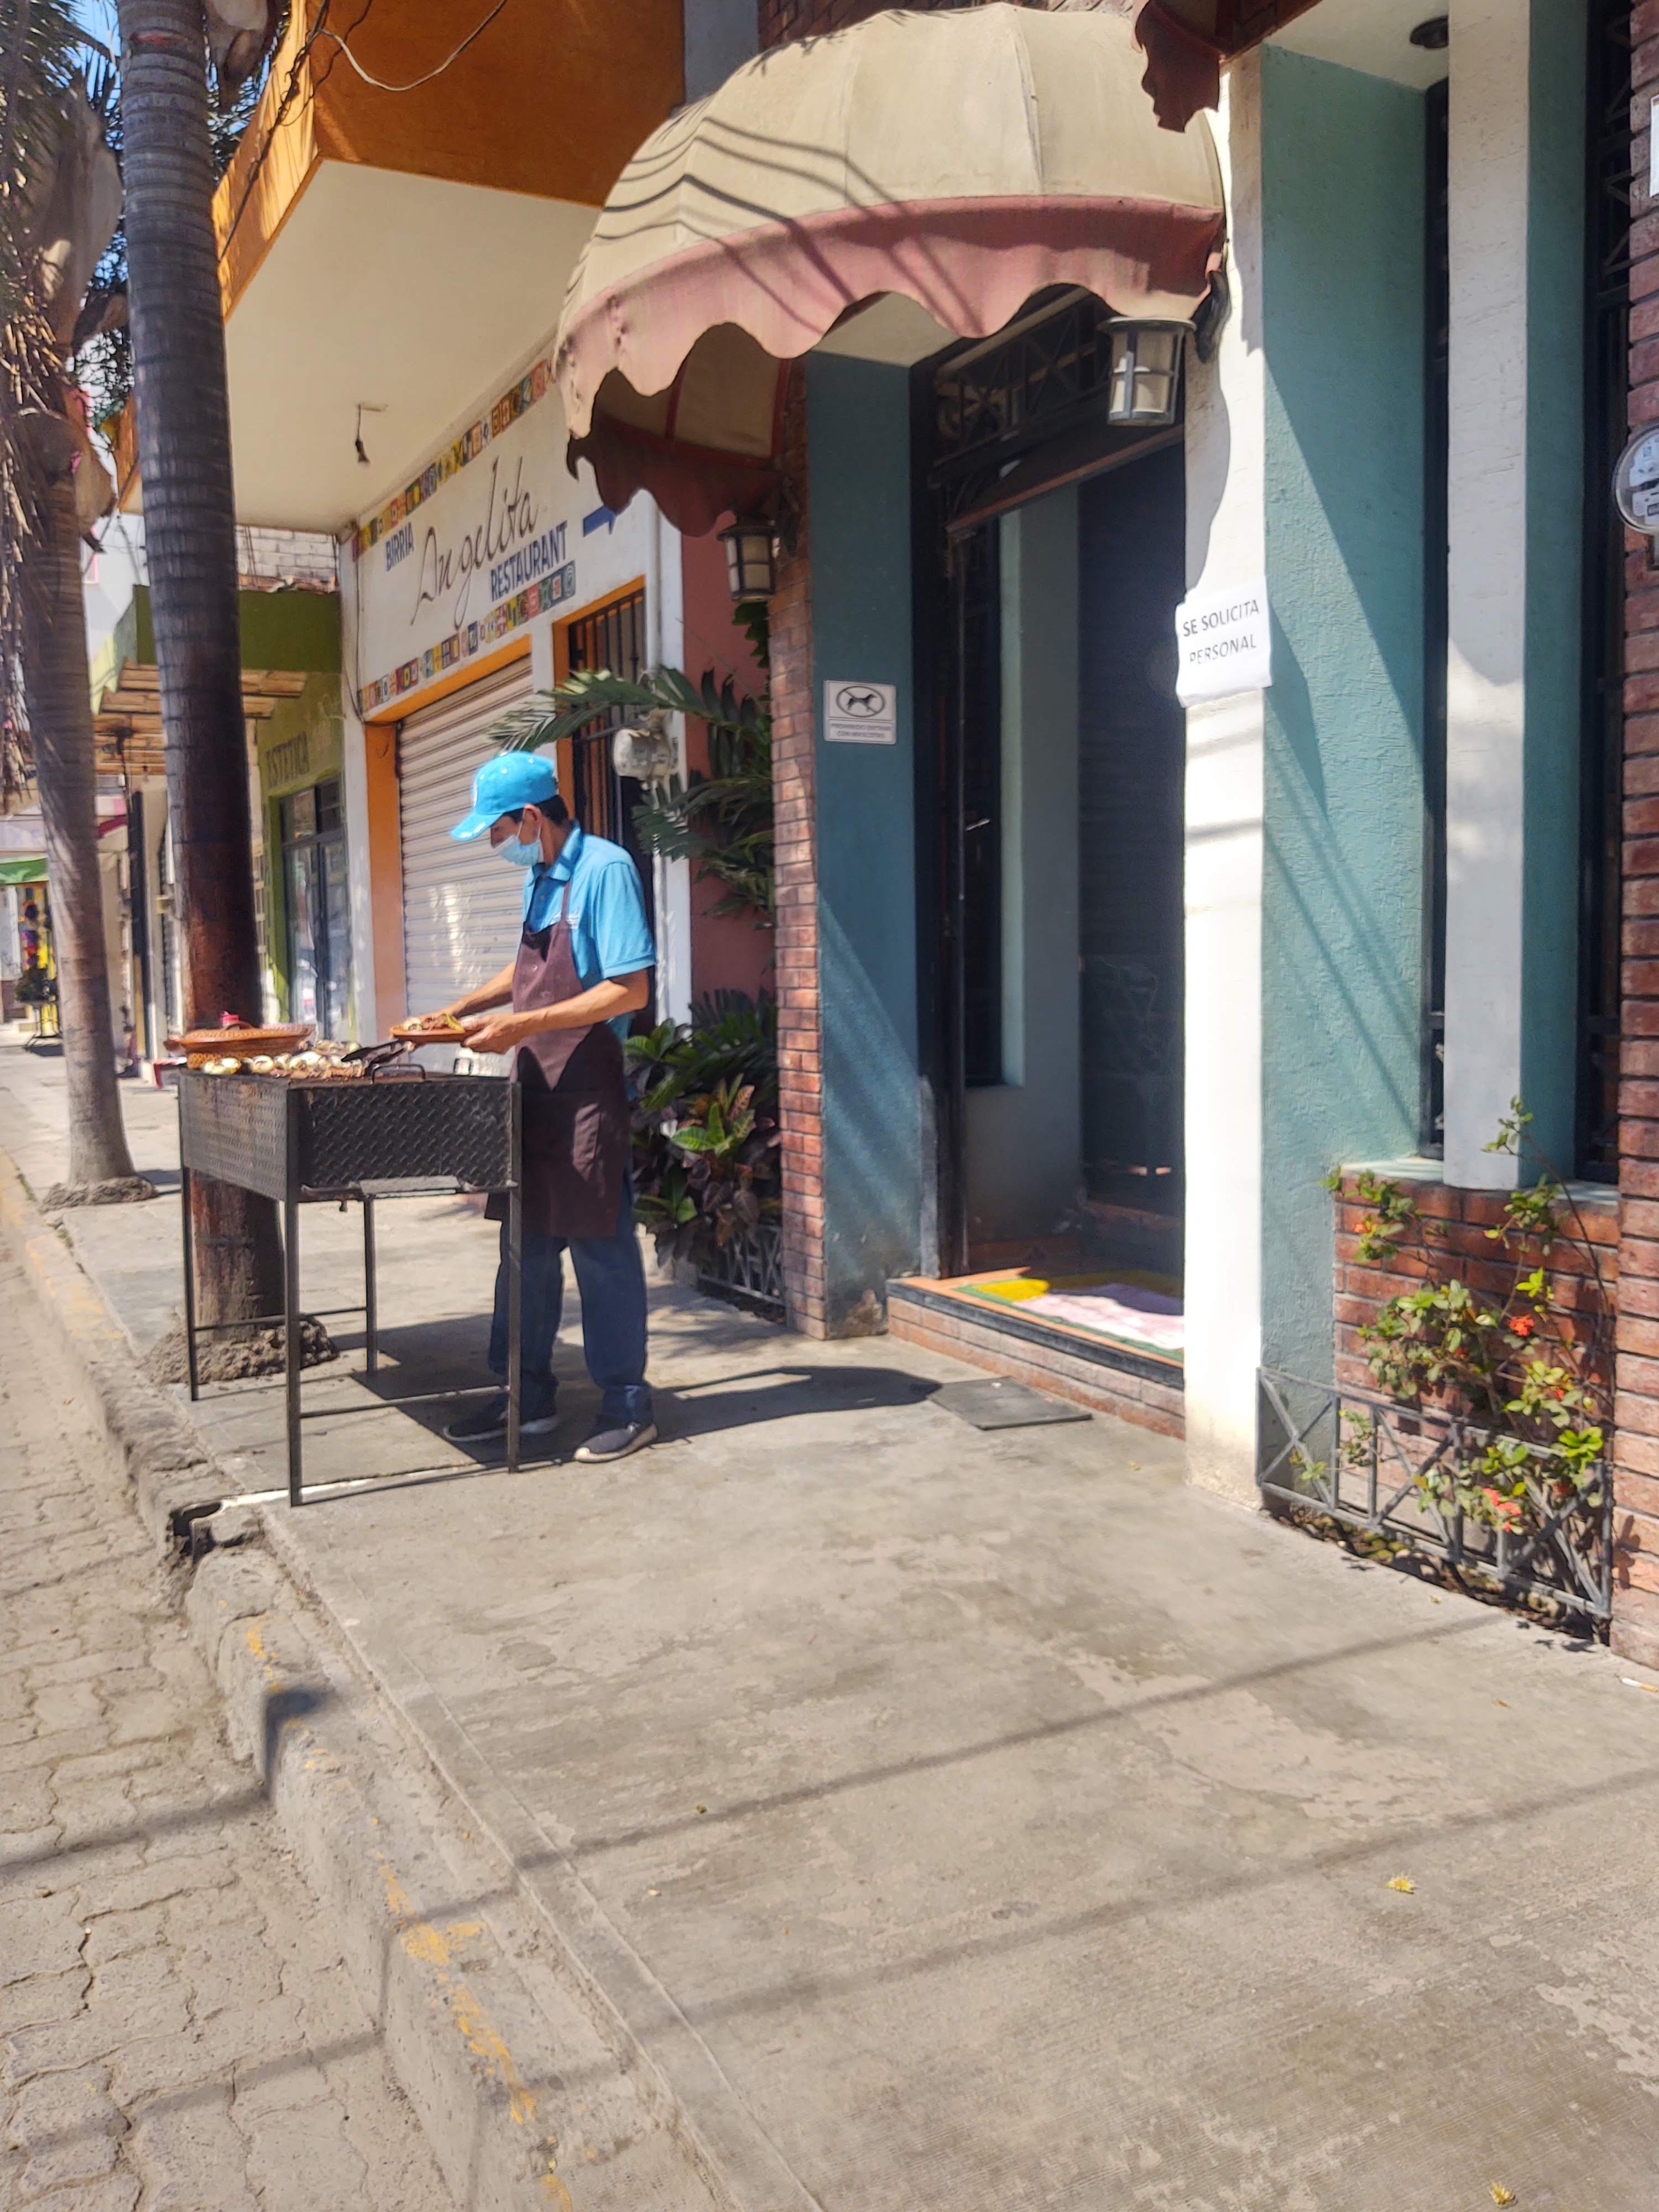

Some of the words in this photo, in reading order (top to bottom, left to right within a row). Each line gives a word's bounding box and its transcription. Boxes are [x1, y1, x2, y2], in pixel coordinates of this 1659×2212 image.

[386, 522, 414, 572] BIRRIA
[410, 456, 539, 629] Angelita
[491, 521, 567, 601] RESTAURANT
[1183, 619, 1198, 637] SE
[1202, 600, 1259, 630] SOLICITA
[1190, 634, 1256, 664] PERSONAL
